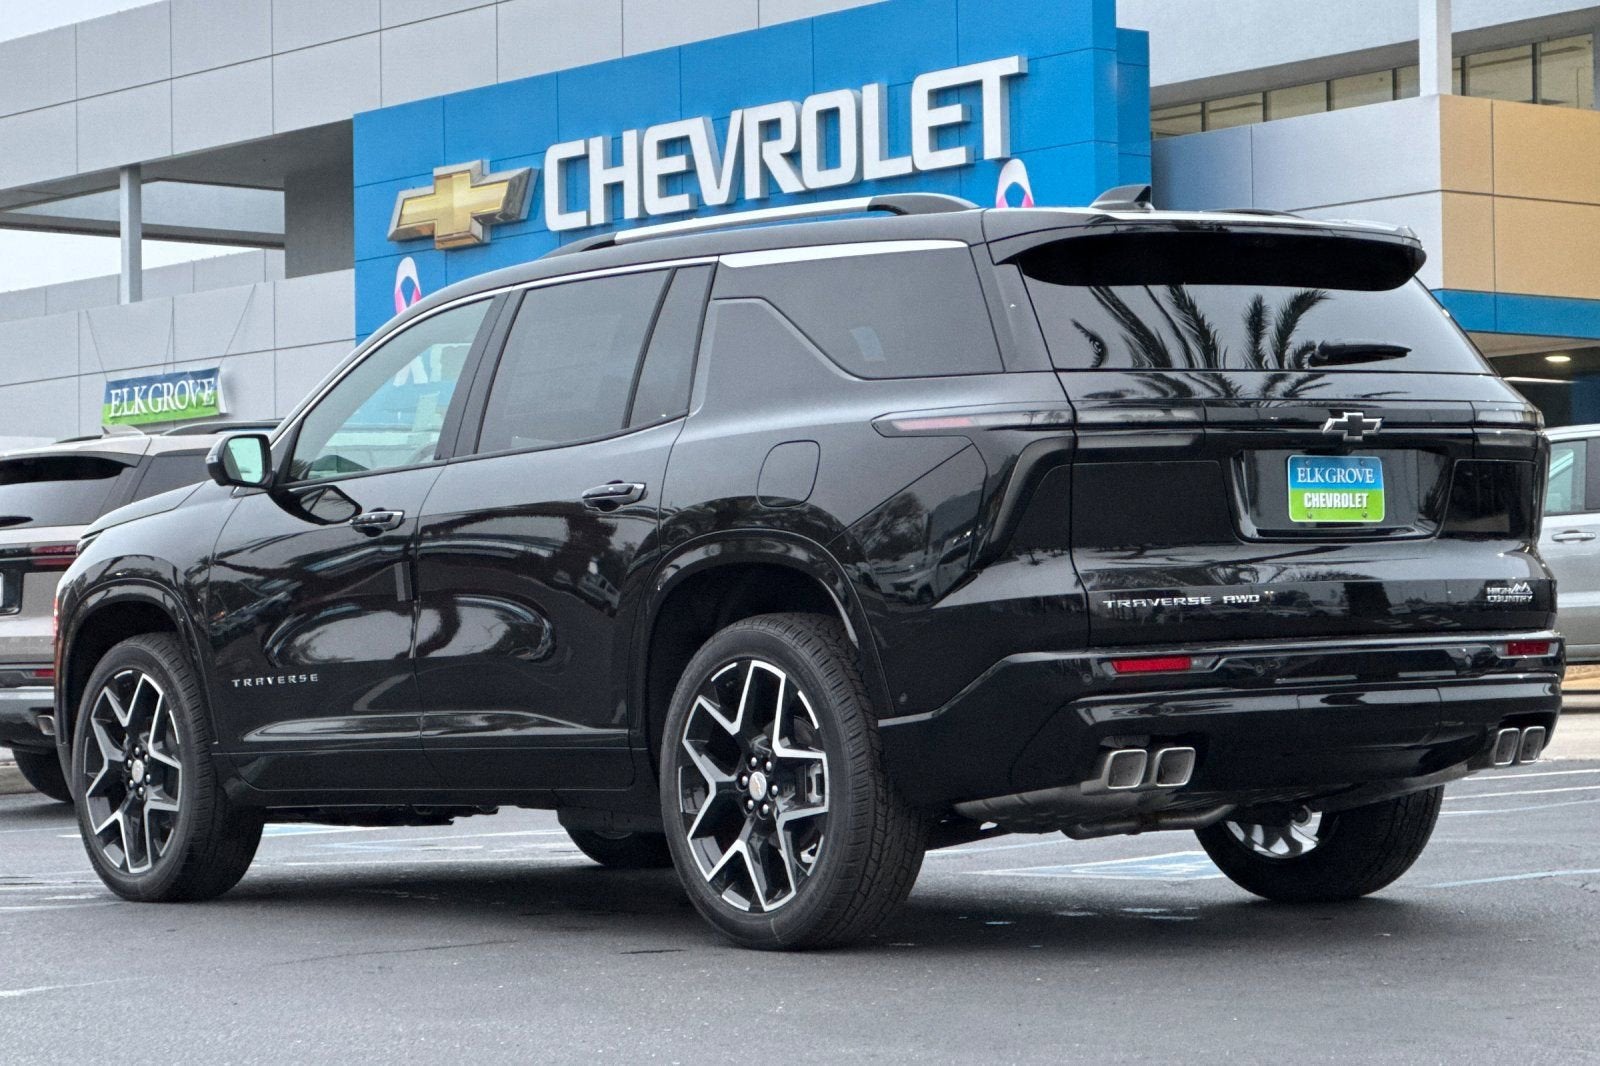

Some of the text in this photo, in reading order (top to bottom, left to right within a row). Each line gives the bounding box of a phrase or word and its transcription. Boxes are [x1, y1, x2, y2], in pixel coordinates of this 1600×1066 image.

[544, 55, 1027, 232] CHEVROLET
[1304, 493, 1368, 508] CHEVROLET
[1103, 594, 1260, 608] TRAVERSE AWD
[231, 673, 319, 688] TRAVERSE
